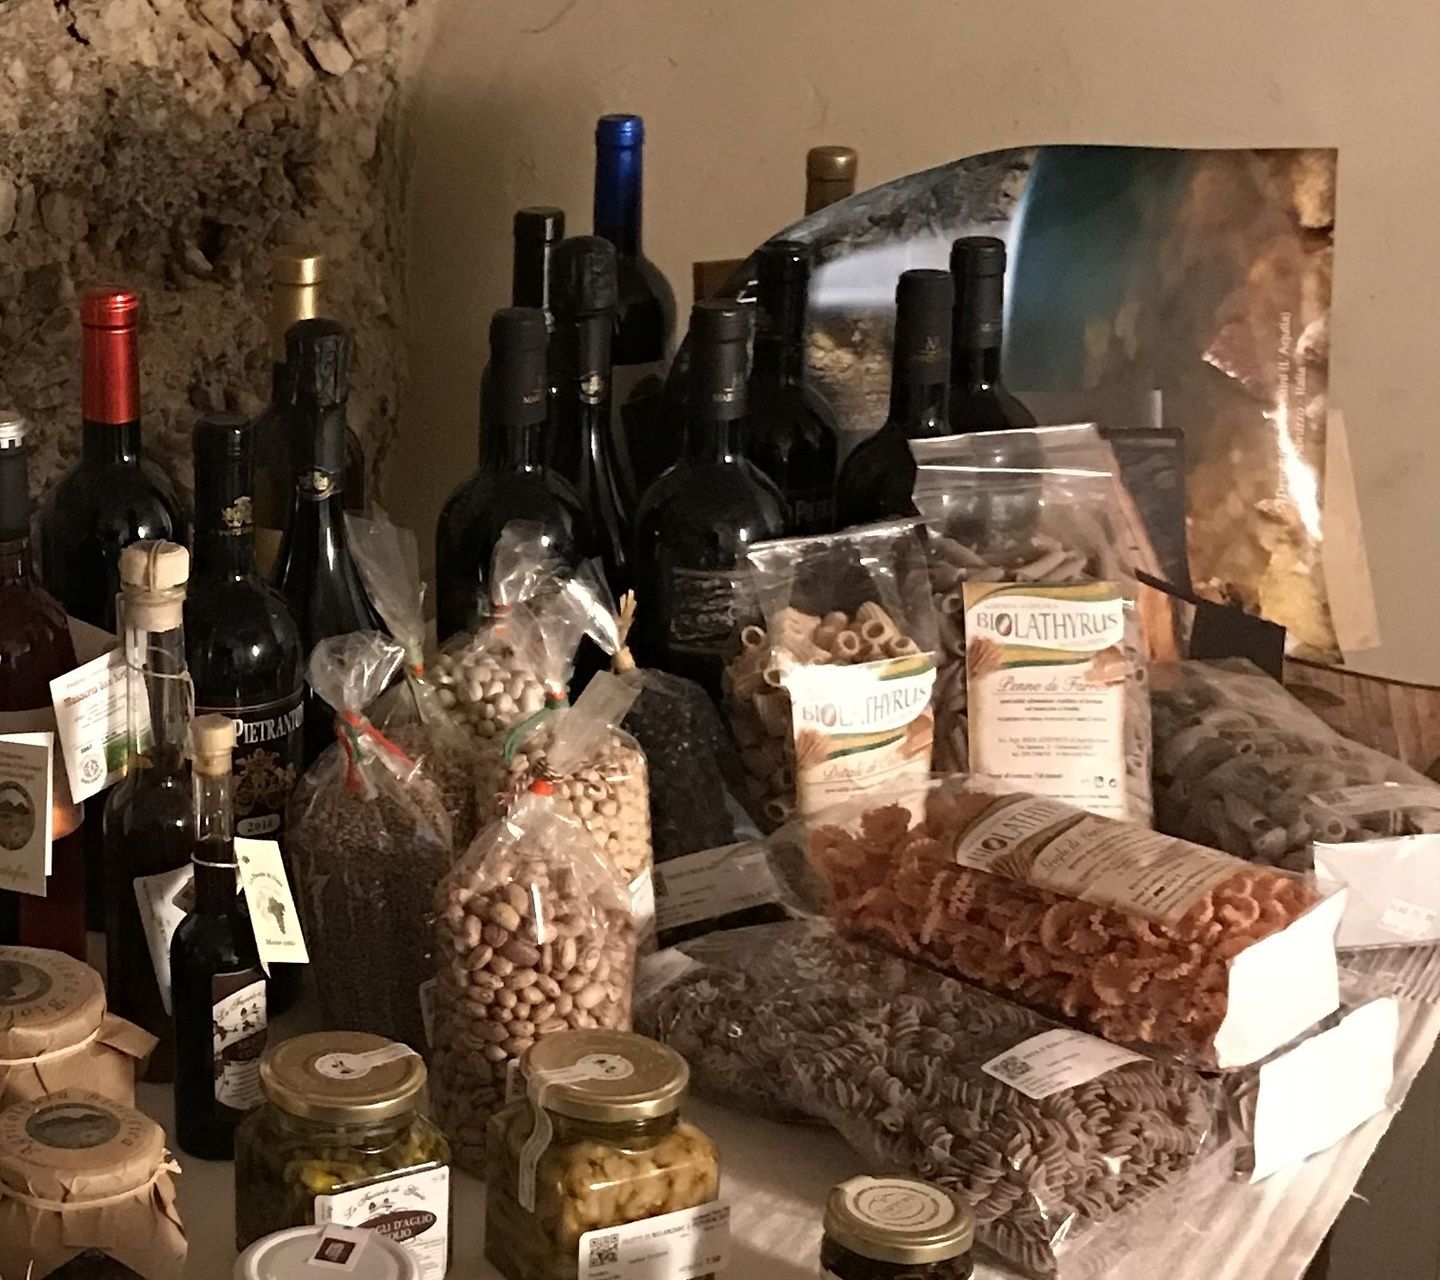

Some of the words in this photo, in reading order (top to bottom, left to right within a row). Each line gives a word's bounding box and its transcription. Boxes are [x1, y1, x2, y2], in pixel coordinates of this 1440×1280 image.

[977, 611, 1118, 640] BIOLATHYRUS
[997, 676, 1041, 693] Penne
[394, 1214, 433, 1231] D'AGLIO
